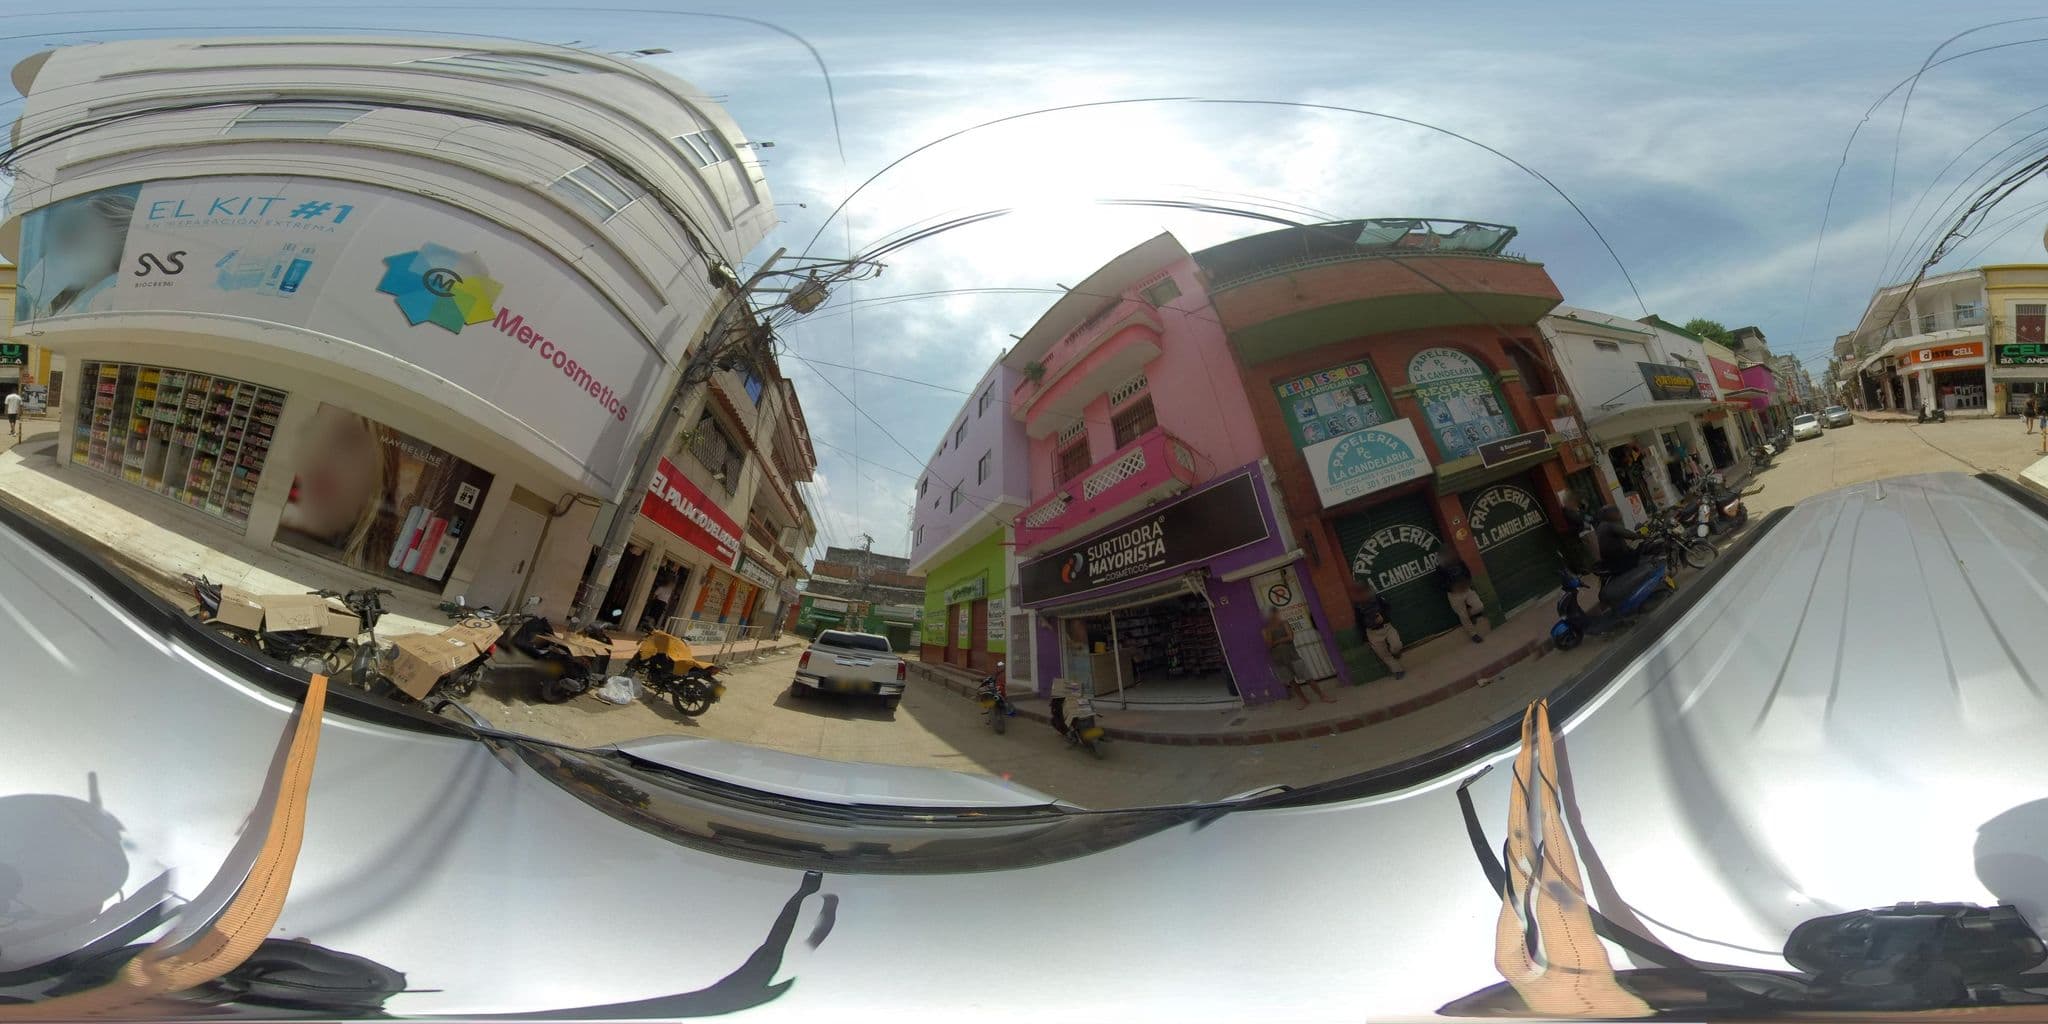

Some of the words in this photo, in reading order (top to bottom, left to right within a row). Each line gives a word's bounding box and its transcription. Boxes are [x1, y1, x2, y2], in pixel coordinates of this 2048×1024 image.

[148, 200, 195, 220] EL
[208, 196, 286, 217] KIT
[290, 200, 356, 225] #1
[265, 218, 336, 234] EXTREMA
[492, 306, 629, 422] Mercosmetics
[1414, 350, 1468, 372] PAPELERIA
[1414, 372, 1426, 382] LA
[1427, 366, 1479, 380] CANDELARIA
[1415, 379, 1490, 398] REGRESO
[380, 434, 443, 469] MAYBELLINE
[1333, 432, 1400, 468] PAPELERIA
[1333, 469, 1346, 481] LA
[1348, 450, 1410, 474] CANDELARIA
[650, 470, 669, 499] EL
[1470, 488, 1531, 530] PAPELERIA
[1474, 534, 1490, 550] LA
[1491, 509, 1543, 542] CANDELARIA
[1088, 536, 1166, 577] MAYORISTA
[1353, 526, 1436, 575] PAPELERIA
